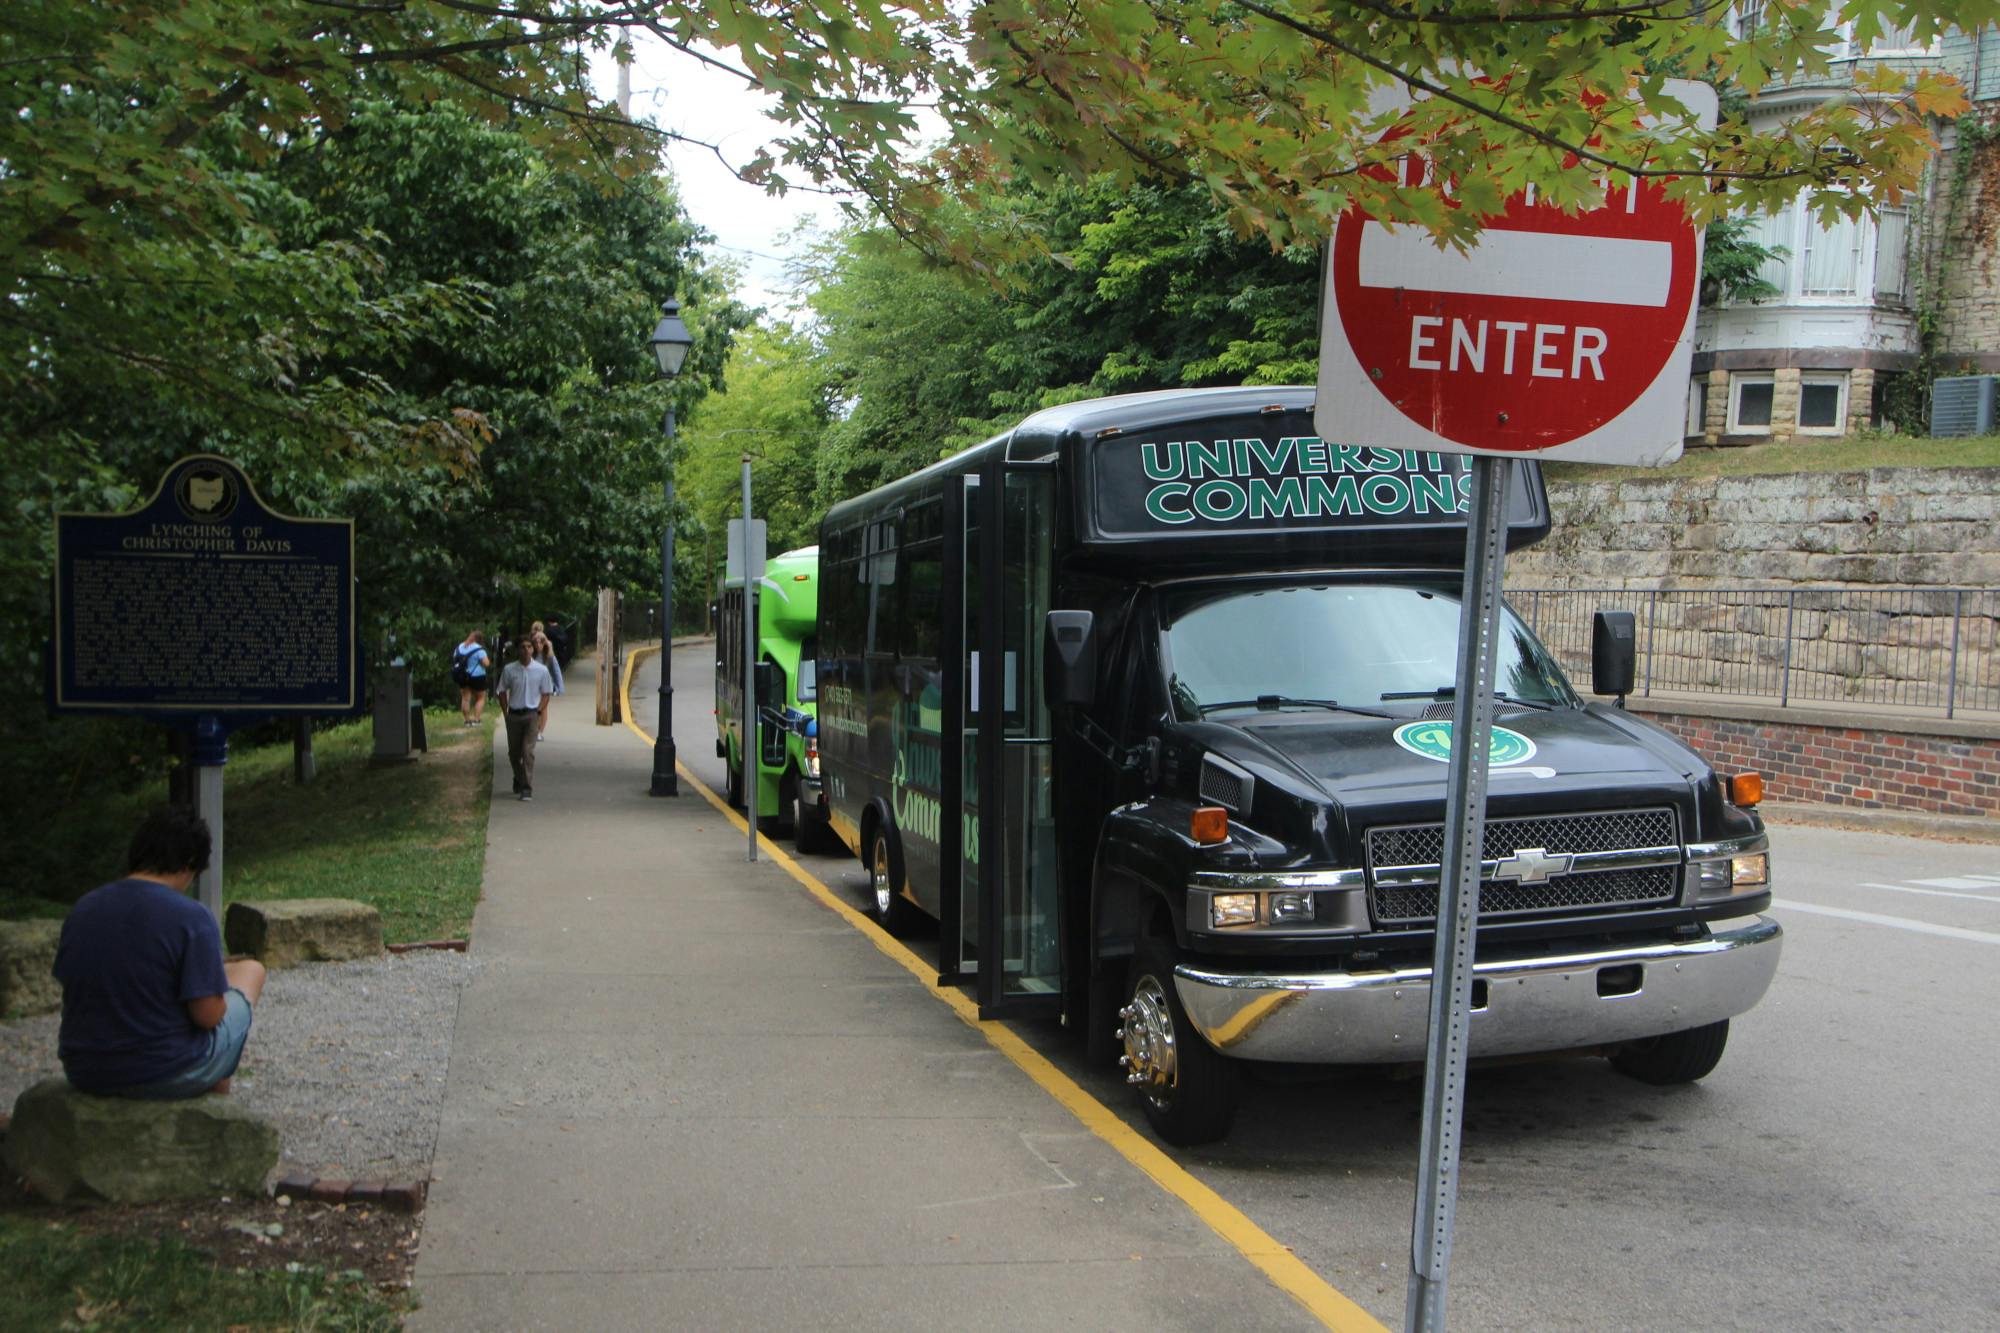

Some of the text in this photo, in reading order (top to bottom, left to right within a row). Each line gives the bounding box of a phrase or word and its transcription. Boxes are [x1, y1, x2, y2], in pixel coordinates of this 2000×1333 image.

[1408, 315, 1609, 381] ENTER
[151, 523, 263, 539] LYNCHING OF
[122, 536, 291, 553] CHRISTOPHER DAVIS
